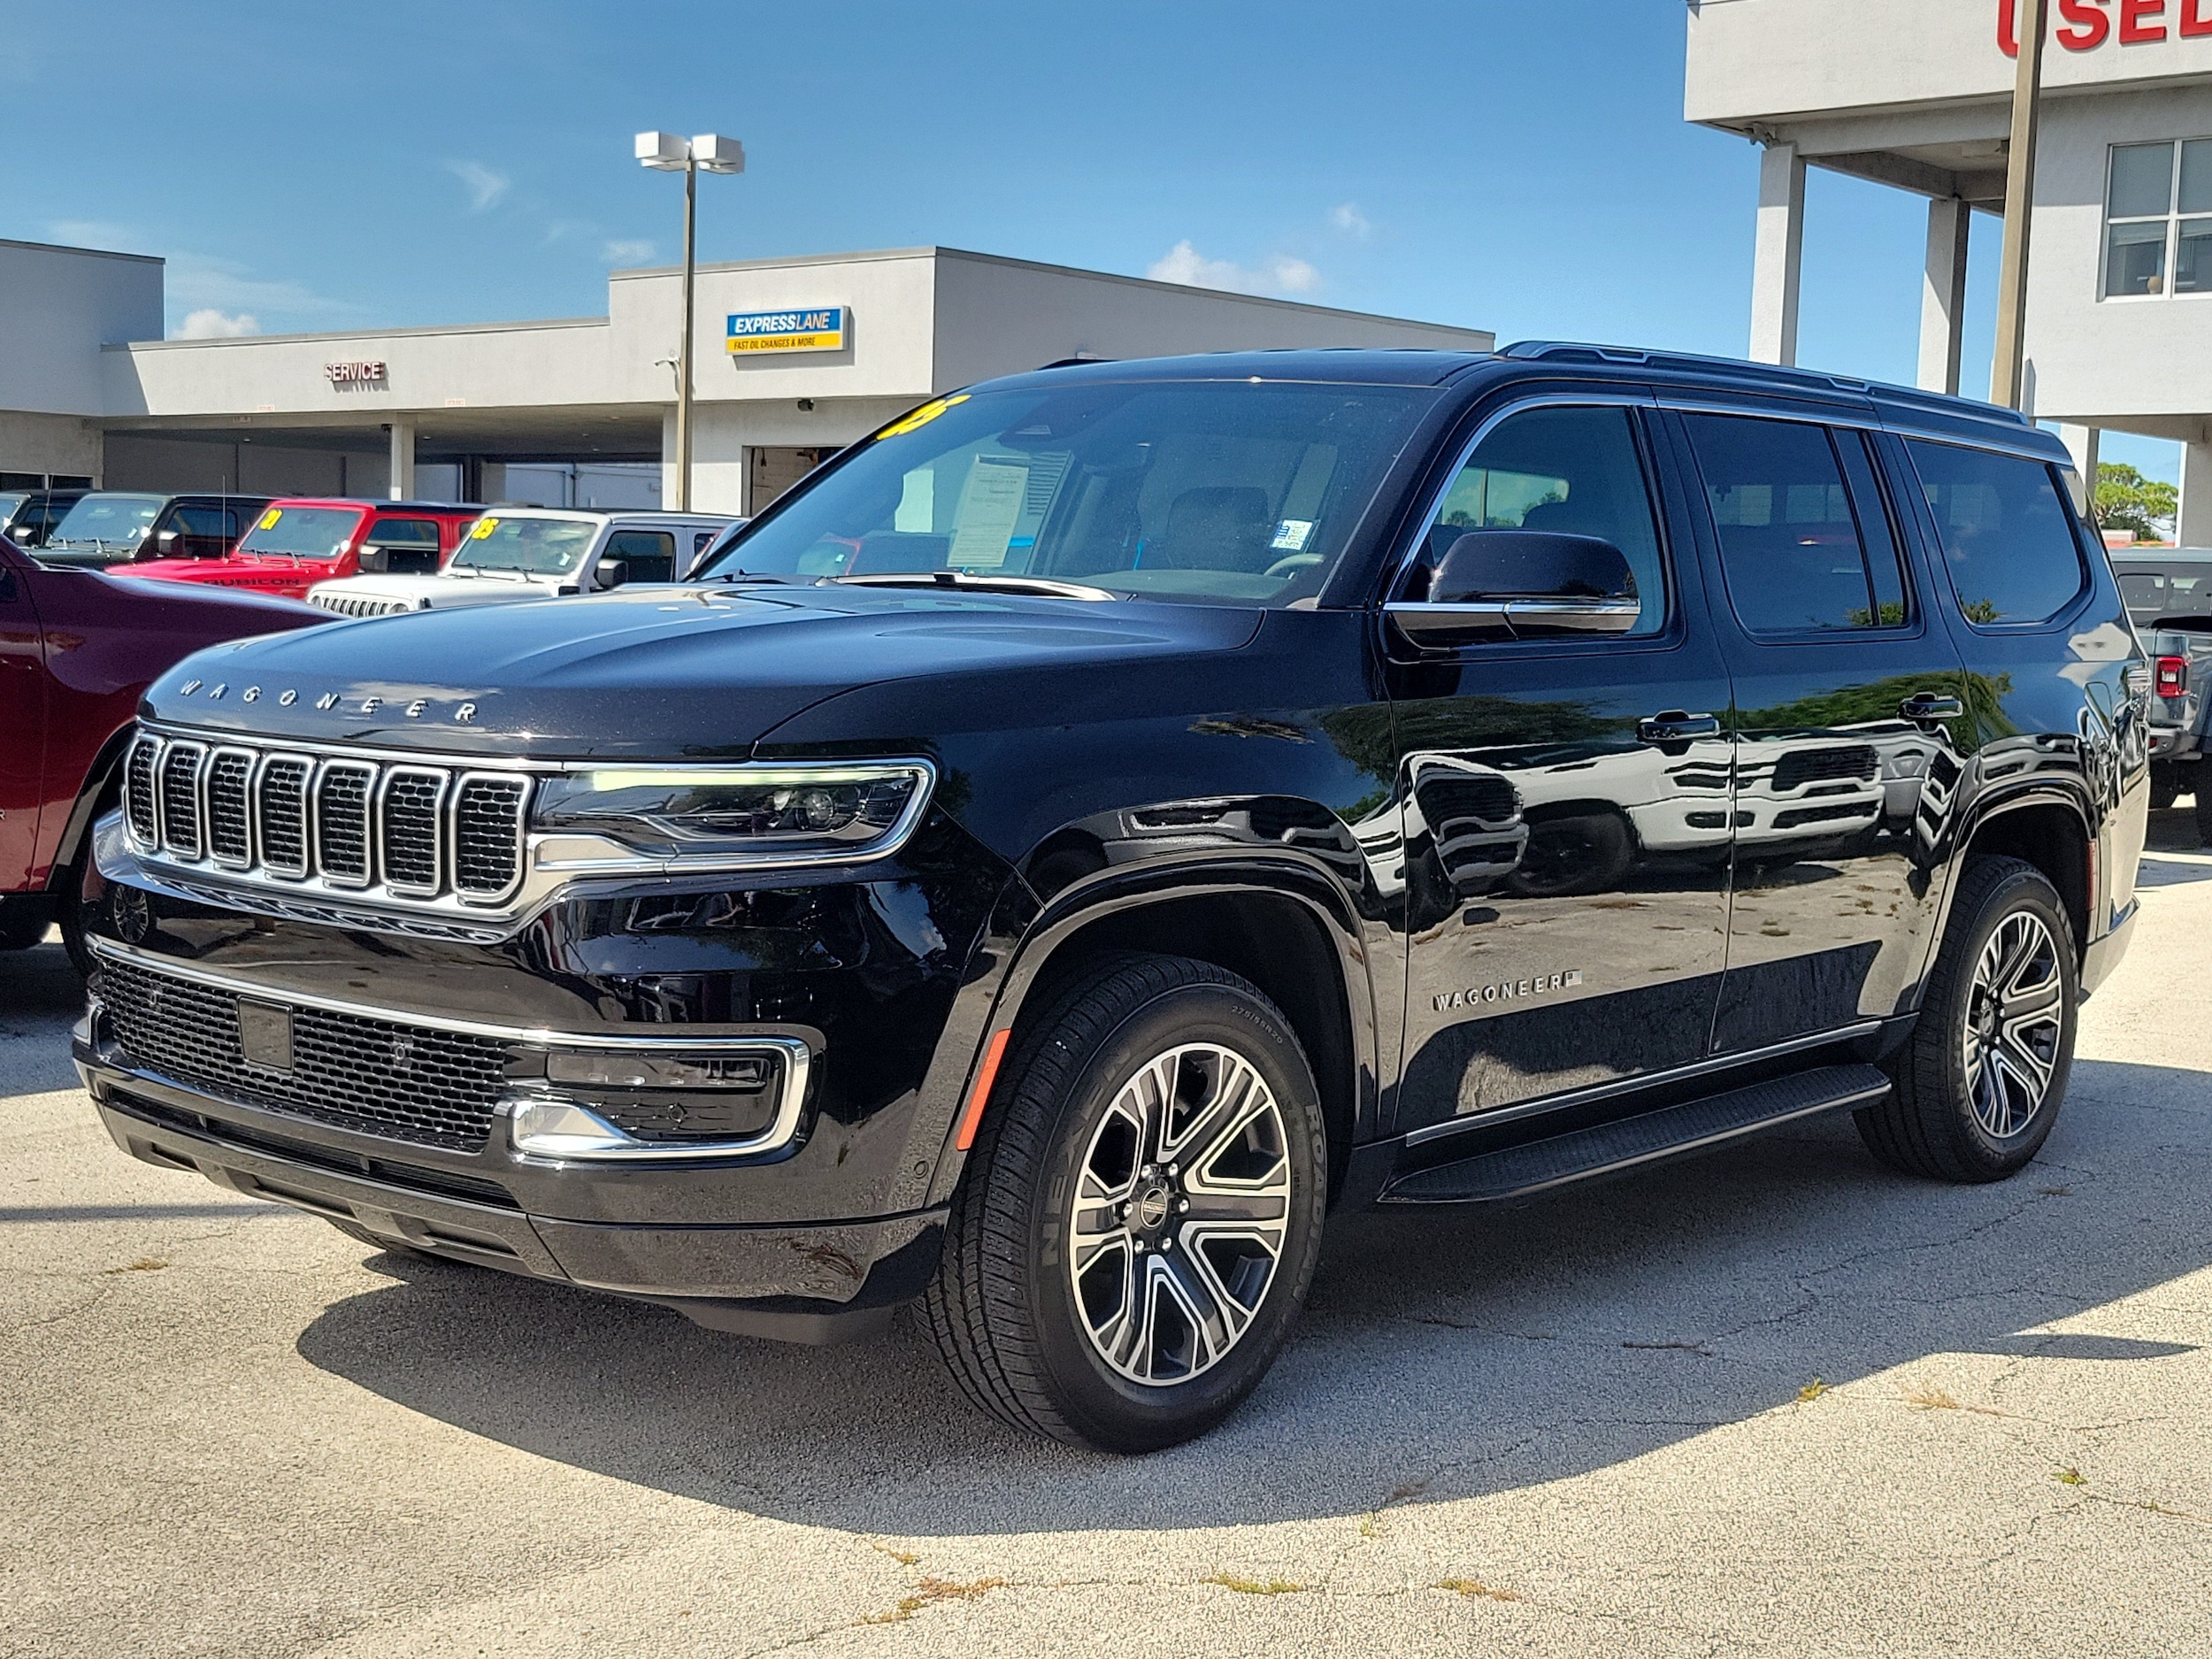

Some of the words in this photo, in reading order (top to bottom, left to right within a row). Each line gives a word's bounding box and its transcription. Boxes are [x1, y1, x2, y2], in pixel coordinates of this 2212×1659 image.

[733, 341, 749, 349] FAST
[749, 340, 759, 349] OIL
[761, 338, 789, 348] CHANGES
[797, 337, 815, 346] MORE
[325, 361, 385, 381] SERVICE
[180, 680, 478, 722] WAGONEER
[1433, 974, 1560, 1011] WAGONEER
